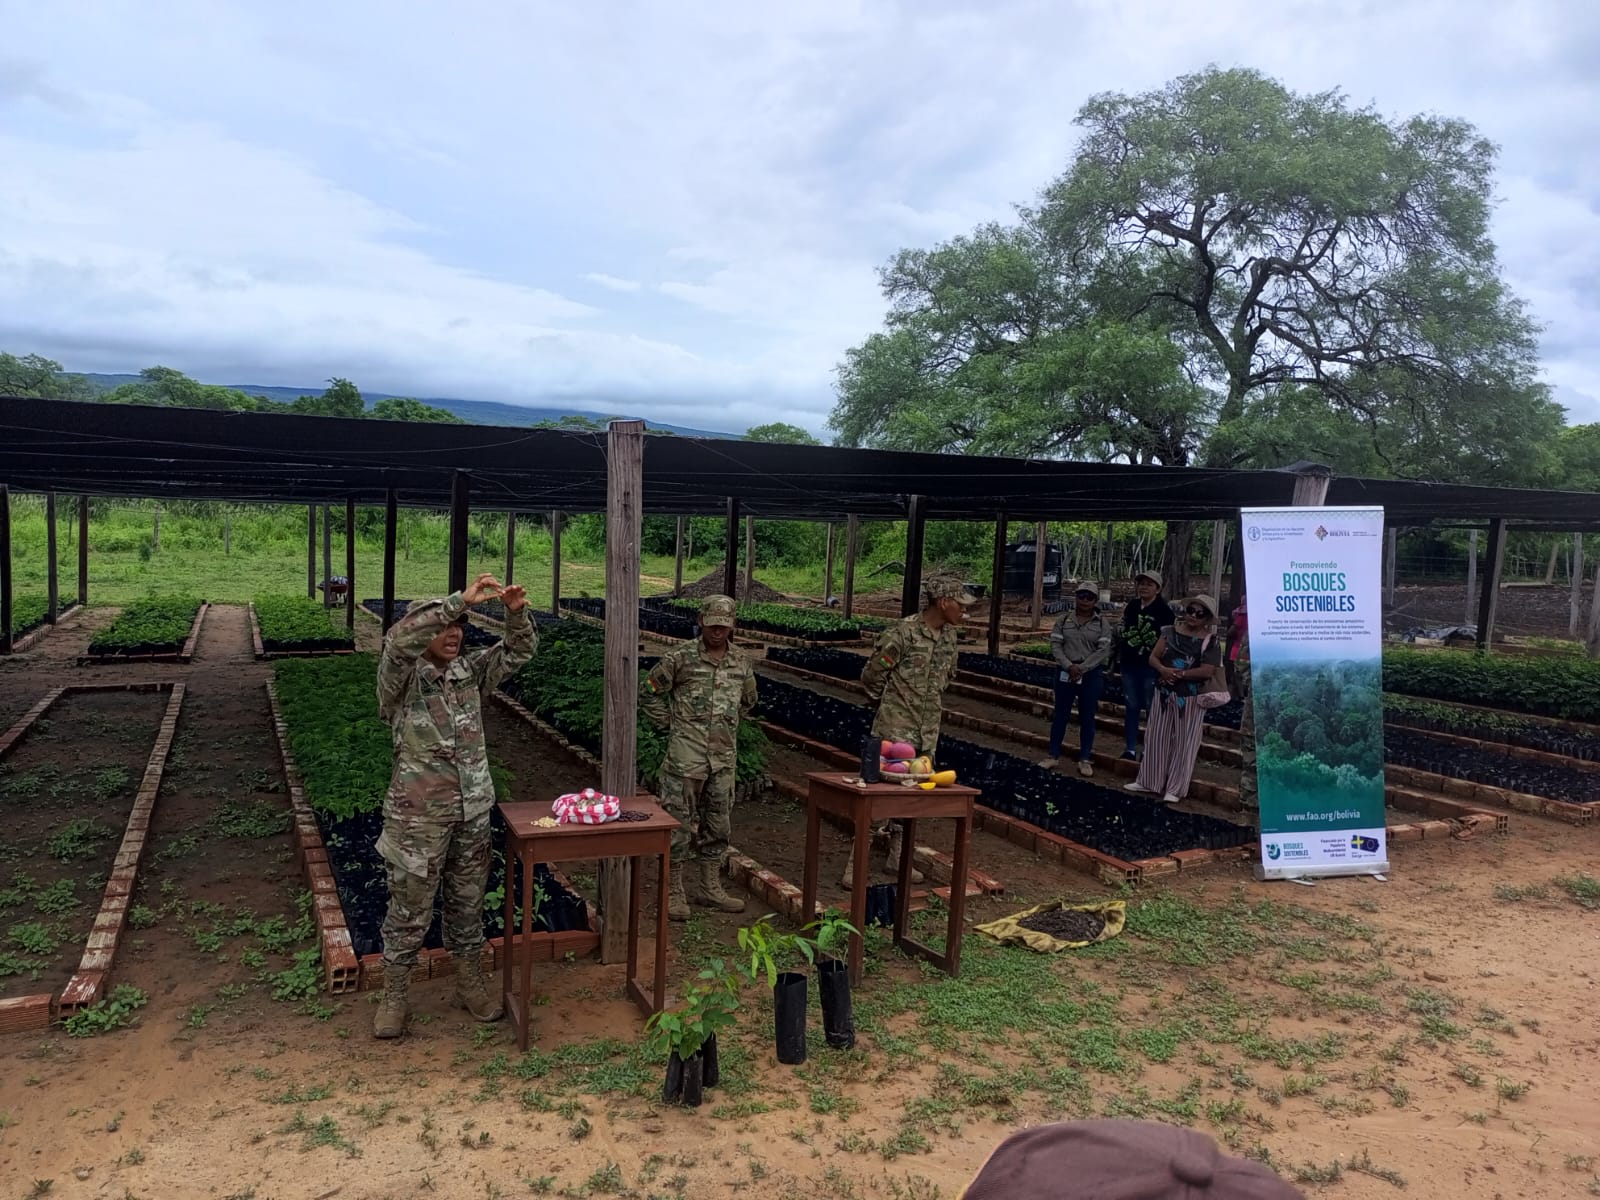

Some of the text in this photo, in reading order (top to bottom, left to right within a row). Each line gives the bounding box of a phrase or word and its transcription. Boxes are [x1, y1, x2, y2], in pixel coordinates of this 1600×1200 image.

[1290, 560, 1337, 569] Promoviendo
[1283, 572, 1346, 592] BOSQUES
[1276, 595, 1355, 612] SOSTENIBLES
[1286, 809, 1361, 822] www.fao.org/bolivia
